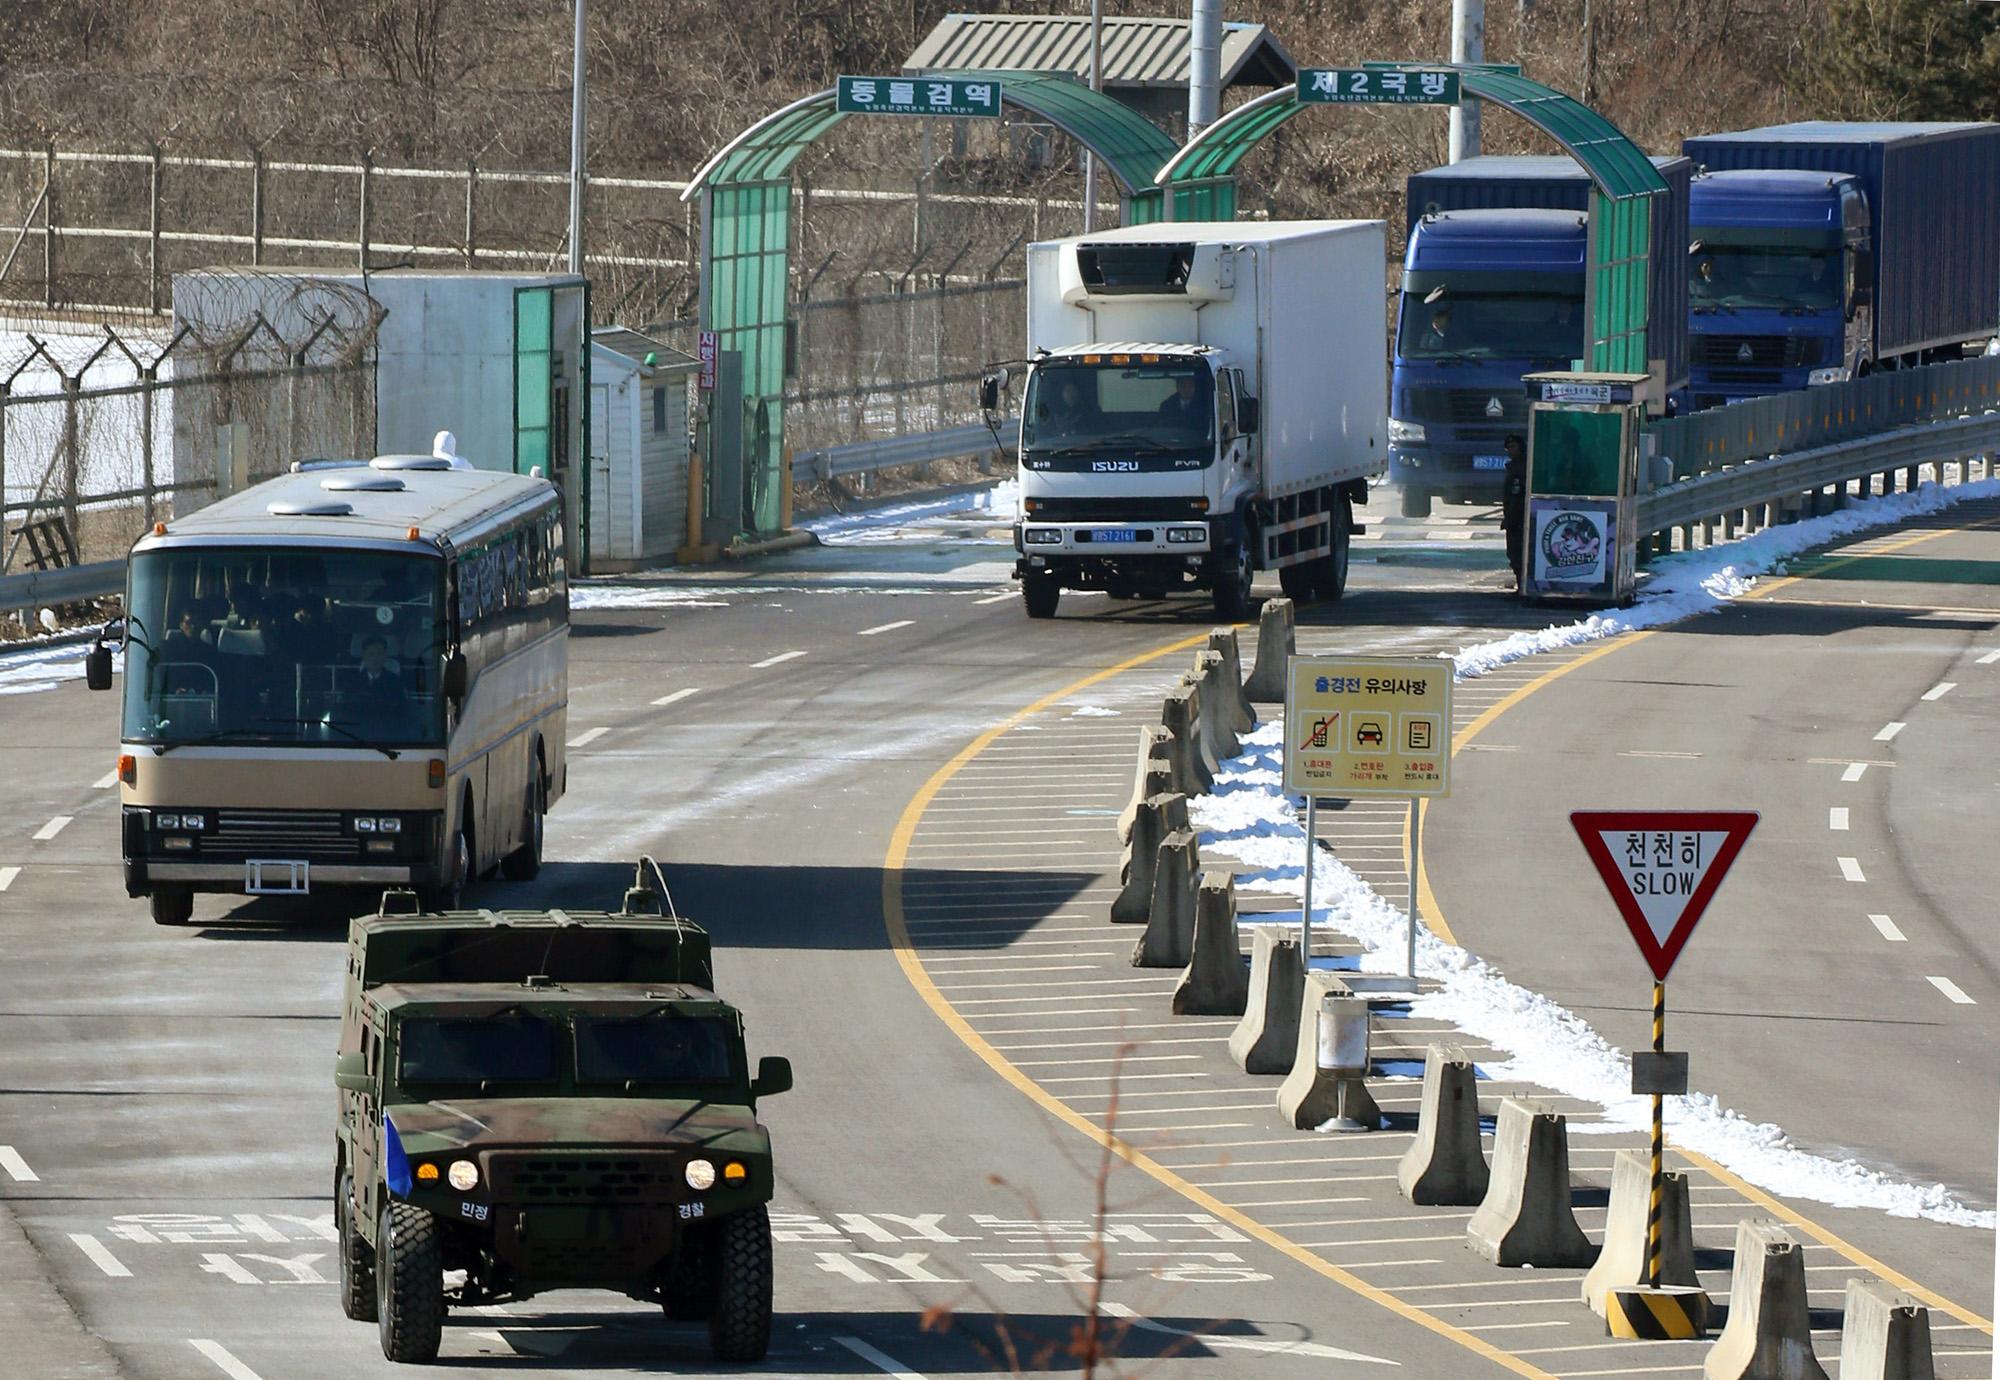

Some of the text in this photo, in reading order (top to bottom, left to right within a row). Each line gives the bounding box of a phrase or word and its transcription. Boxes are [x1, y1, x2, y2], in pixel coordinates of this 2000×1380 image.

[850, 80, 991, 107] 동물검역
[1311, 71, 1448, 95] 제2국방
[1092, 461, 1139, 472] ISUZU
[1315, 676, 1427, 695] 출경전 유의사항
[1625, 832, 1700, 869] 천천히
[1633, 872, 1694, 895] SLOW
[461, 1201, 705, 1221] 민정 경찰
[815, 1252, 1274, 1284] 운전자
